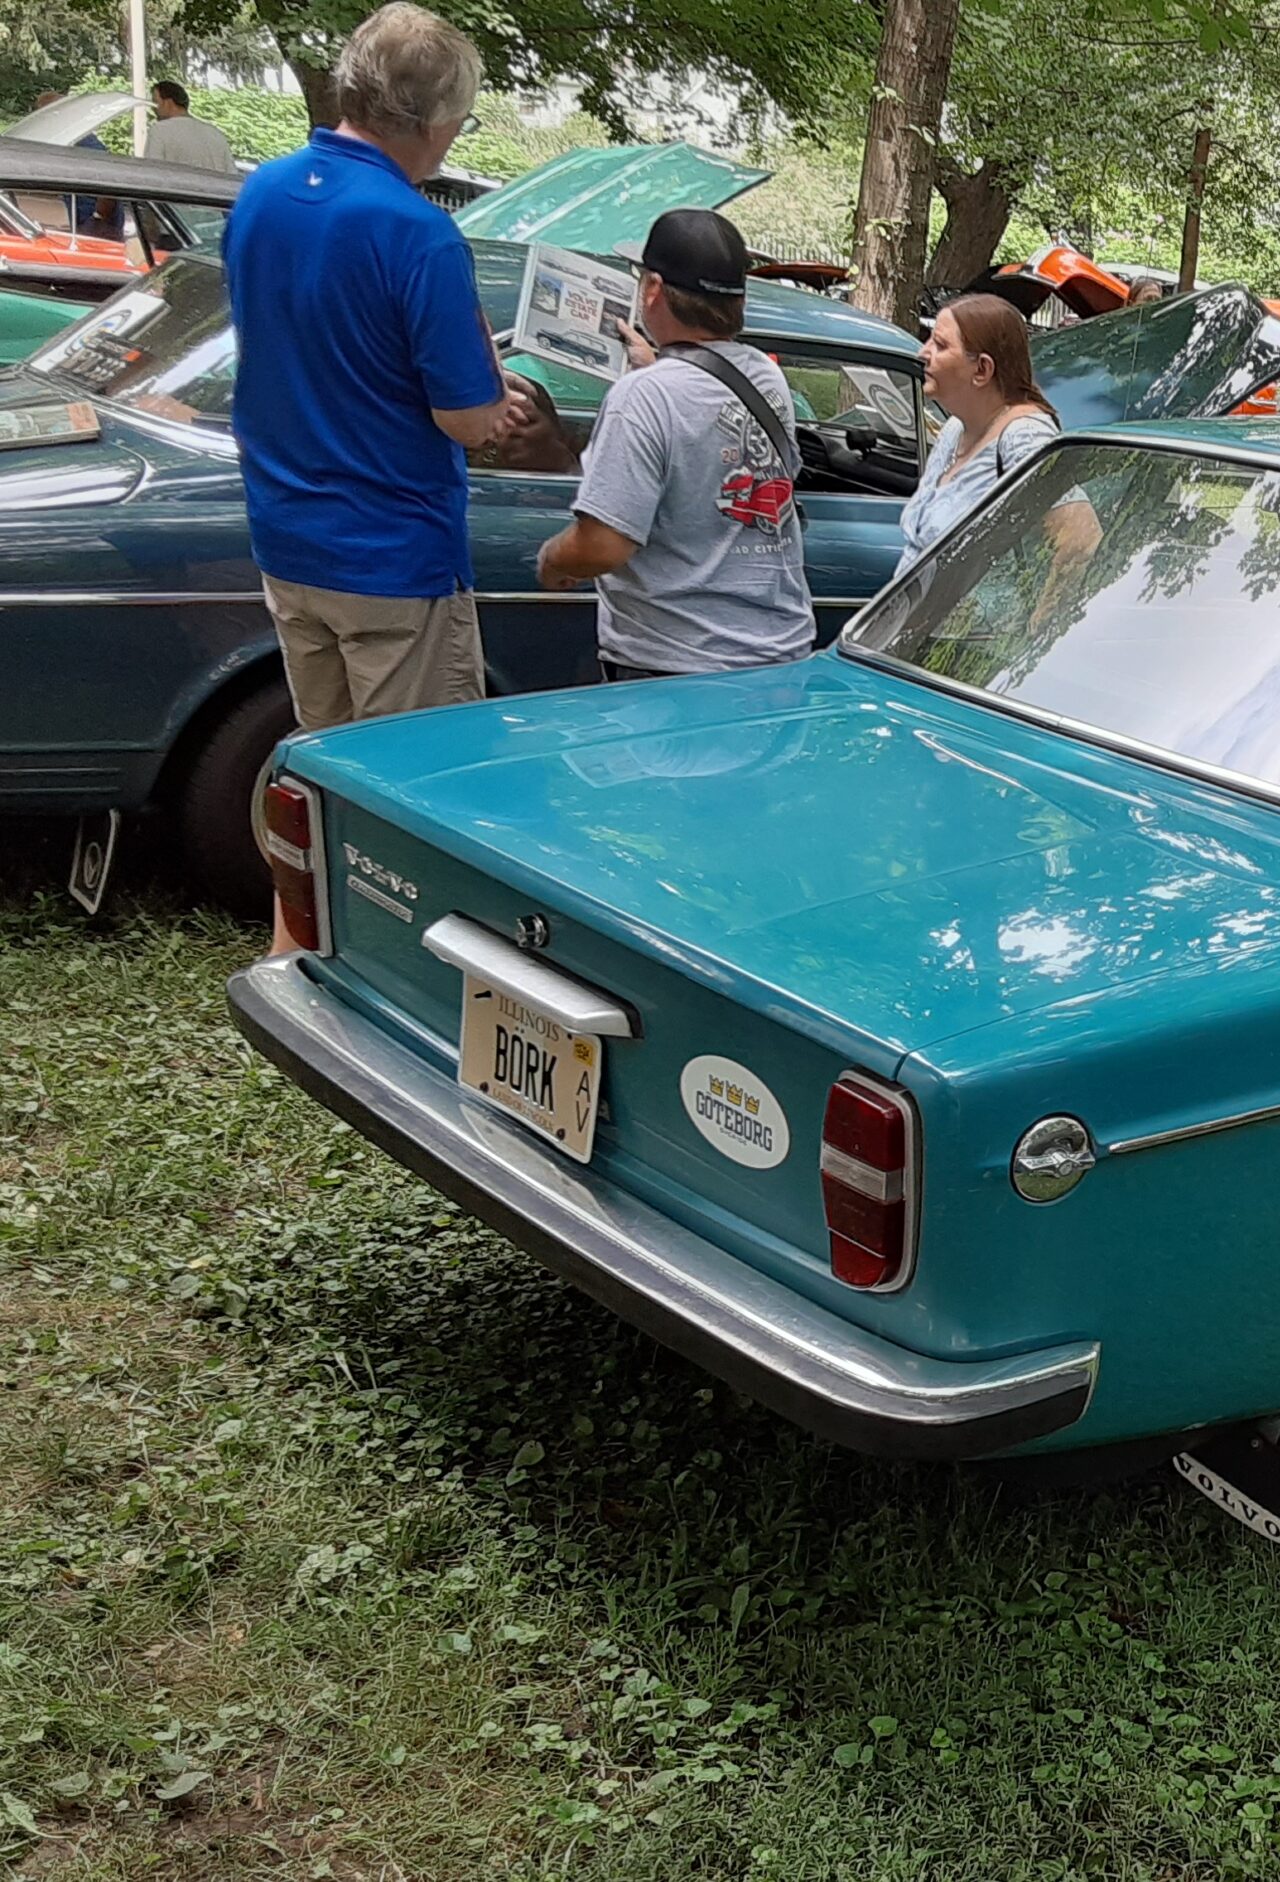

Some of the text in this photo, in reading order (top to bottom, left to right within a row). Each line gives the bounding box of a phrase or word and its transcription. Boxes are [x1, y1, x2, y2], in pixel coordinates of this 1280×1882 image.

[343, 842, 419, 899] VOLVO
[498, 995, 560, 1042] ILLINOIS
[494, 1023, 557, 1113] BÖRK
[696, 1089, 773, 1152] GÖTEBORG
[1176, 1455, 1280, 1538] VOLVO
